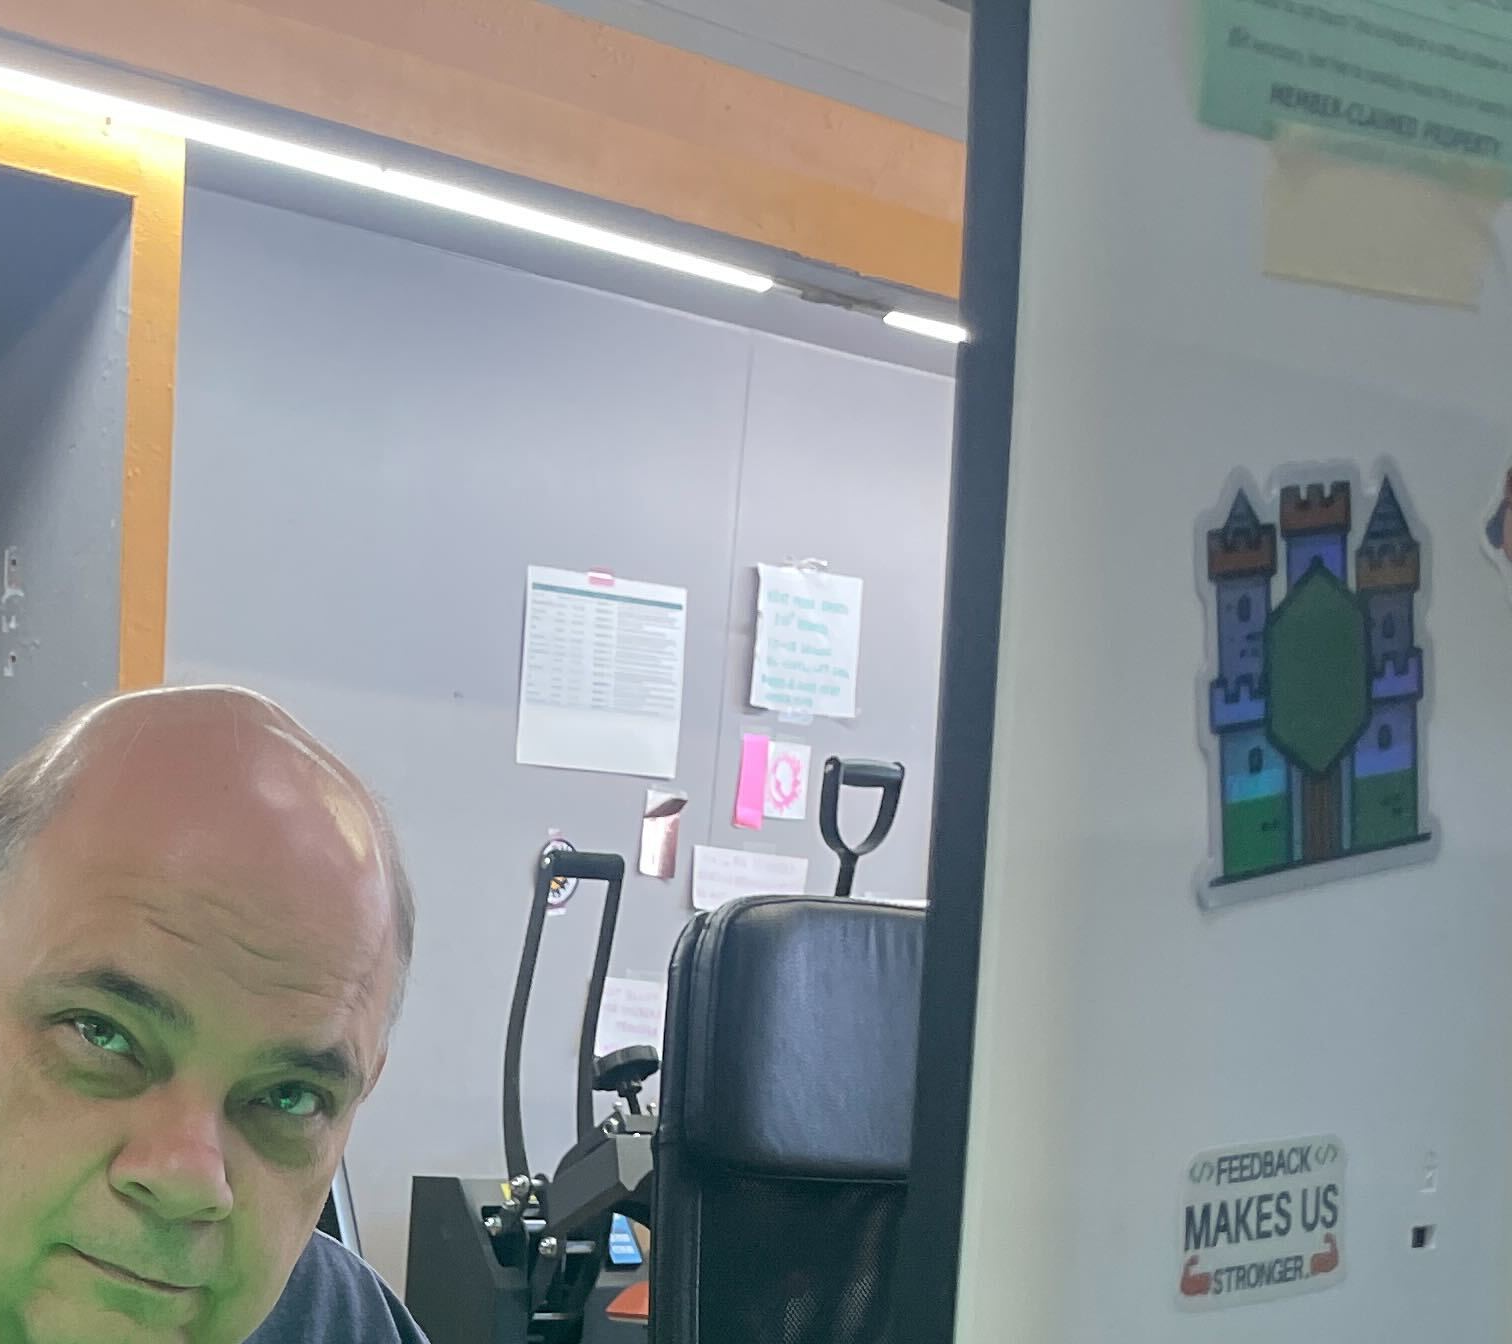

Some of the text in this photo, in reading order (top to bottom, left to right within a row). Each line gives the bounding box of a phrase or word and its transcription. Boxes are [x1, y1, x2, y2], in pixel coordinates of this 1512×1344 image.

[1216, 1144, 1312, 1186] FEEDBACK
[1184, 1183, 1339, 1251] MAKES US
